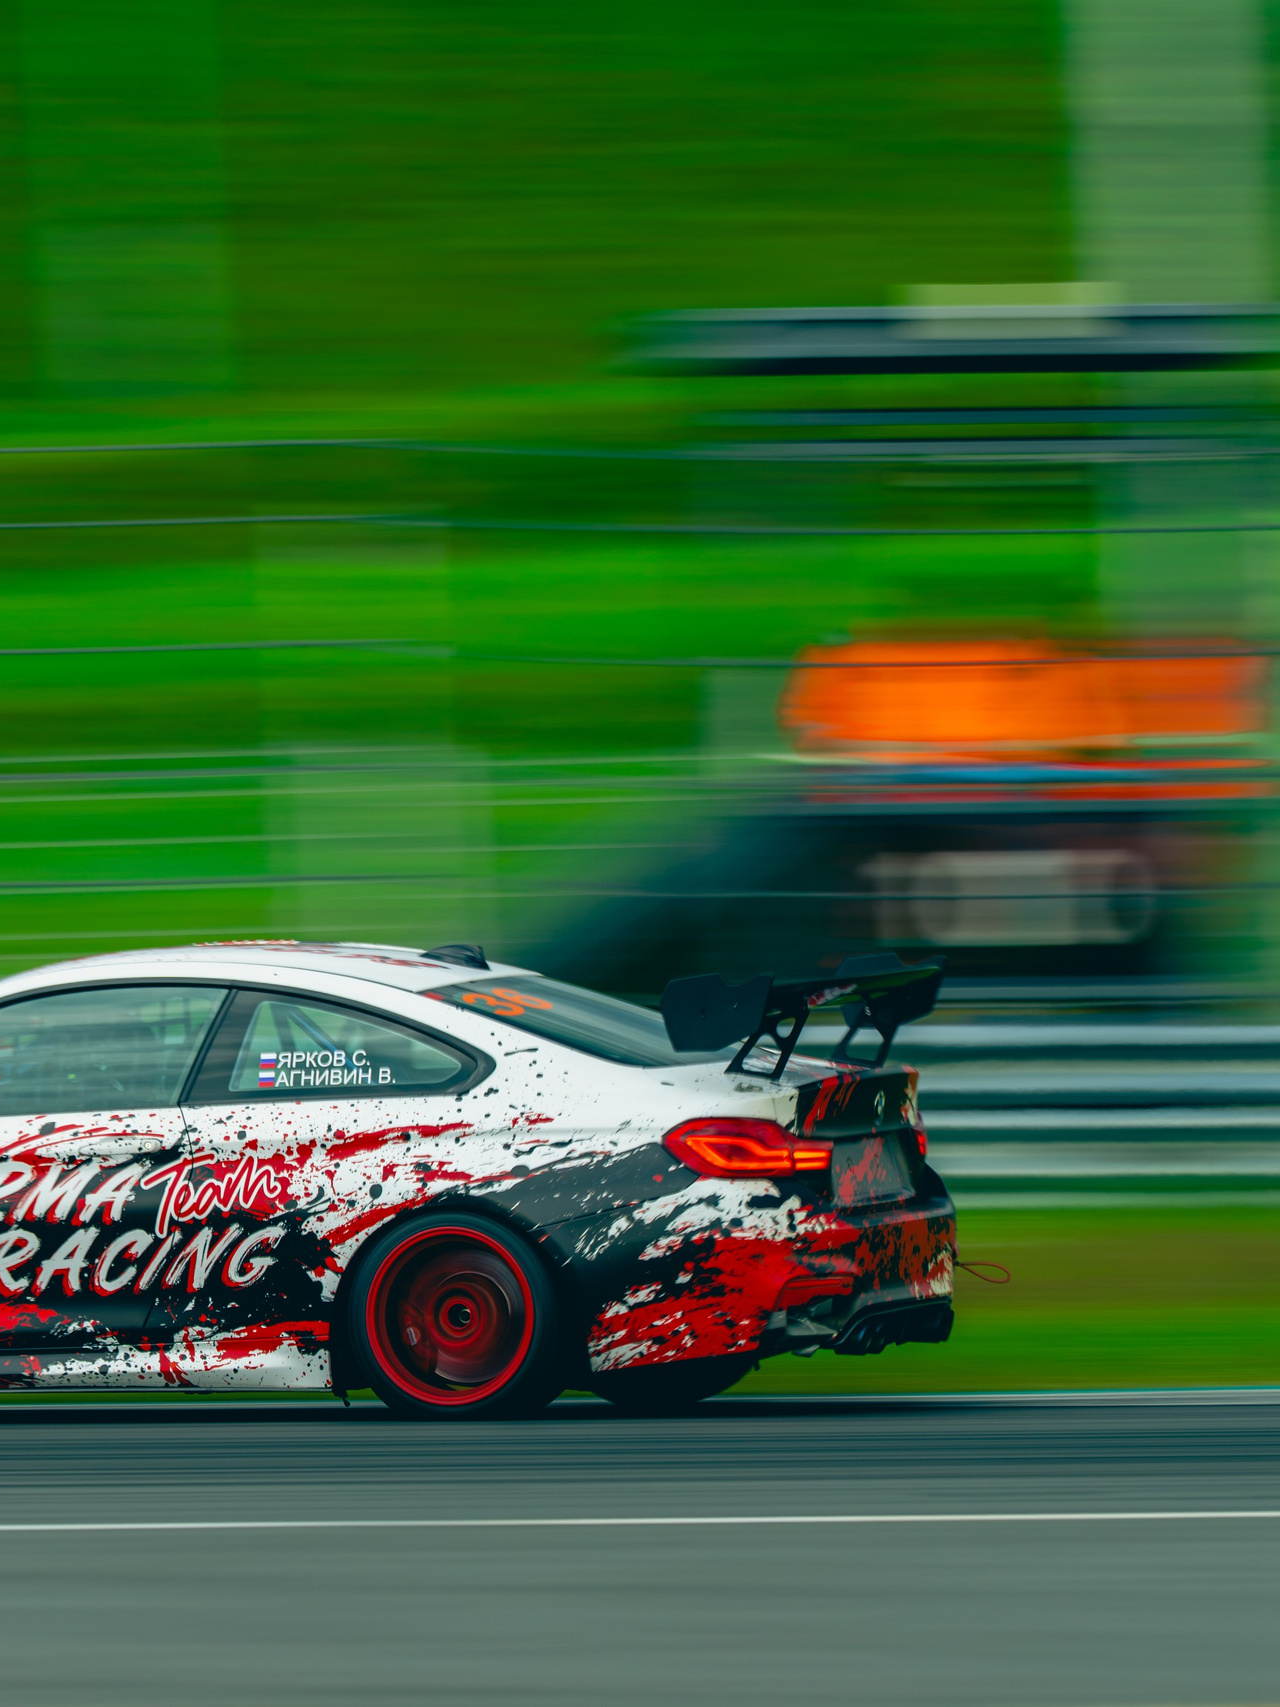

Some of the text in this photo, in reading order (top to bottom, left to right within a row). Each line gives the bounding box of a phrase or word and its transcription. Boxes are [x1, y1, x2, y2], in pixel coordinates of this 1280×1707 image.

[461, 987, 553, 1016] 36
[276, 1049, 371, 1069] ЯРКОВ С.
[274, 1066, 397, 1087] АГНИВИН В.
[140, 1151, 282, 1239] Team
